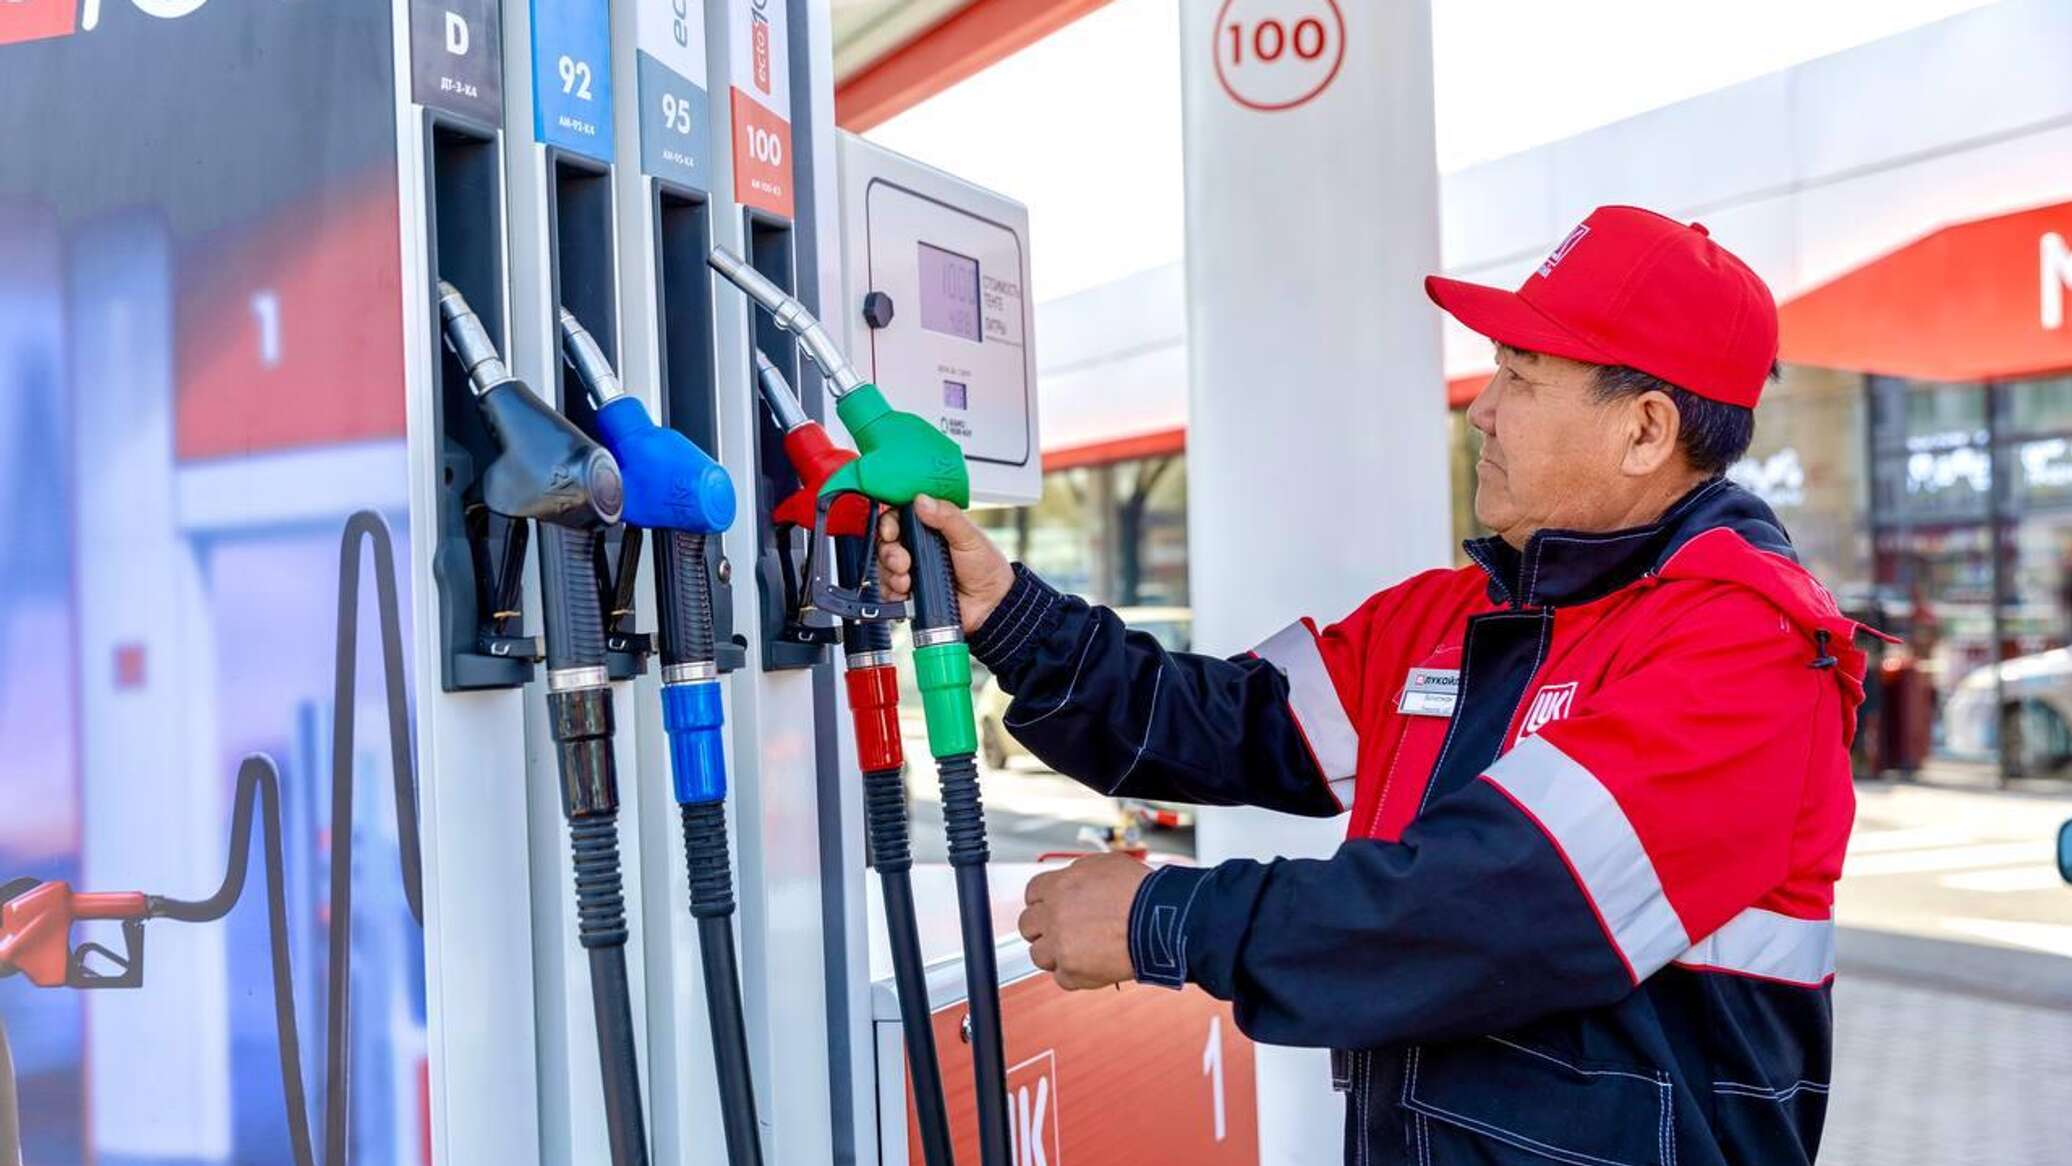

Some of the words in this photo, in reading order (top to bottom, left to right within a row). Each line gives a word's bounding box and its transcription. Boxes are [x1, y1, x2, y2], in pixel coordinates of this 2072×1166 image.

[445, 11, 469, 55] D
[1229, 18, 1325, 65] 100
[558, 55, 592, 101] 92
[661, 93, 691, 135] 95
[746, 124, 782, 168] 100
[251, 292, 282, 367] 1
[1203, 1014, 1227, 1142] 1
